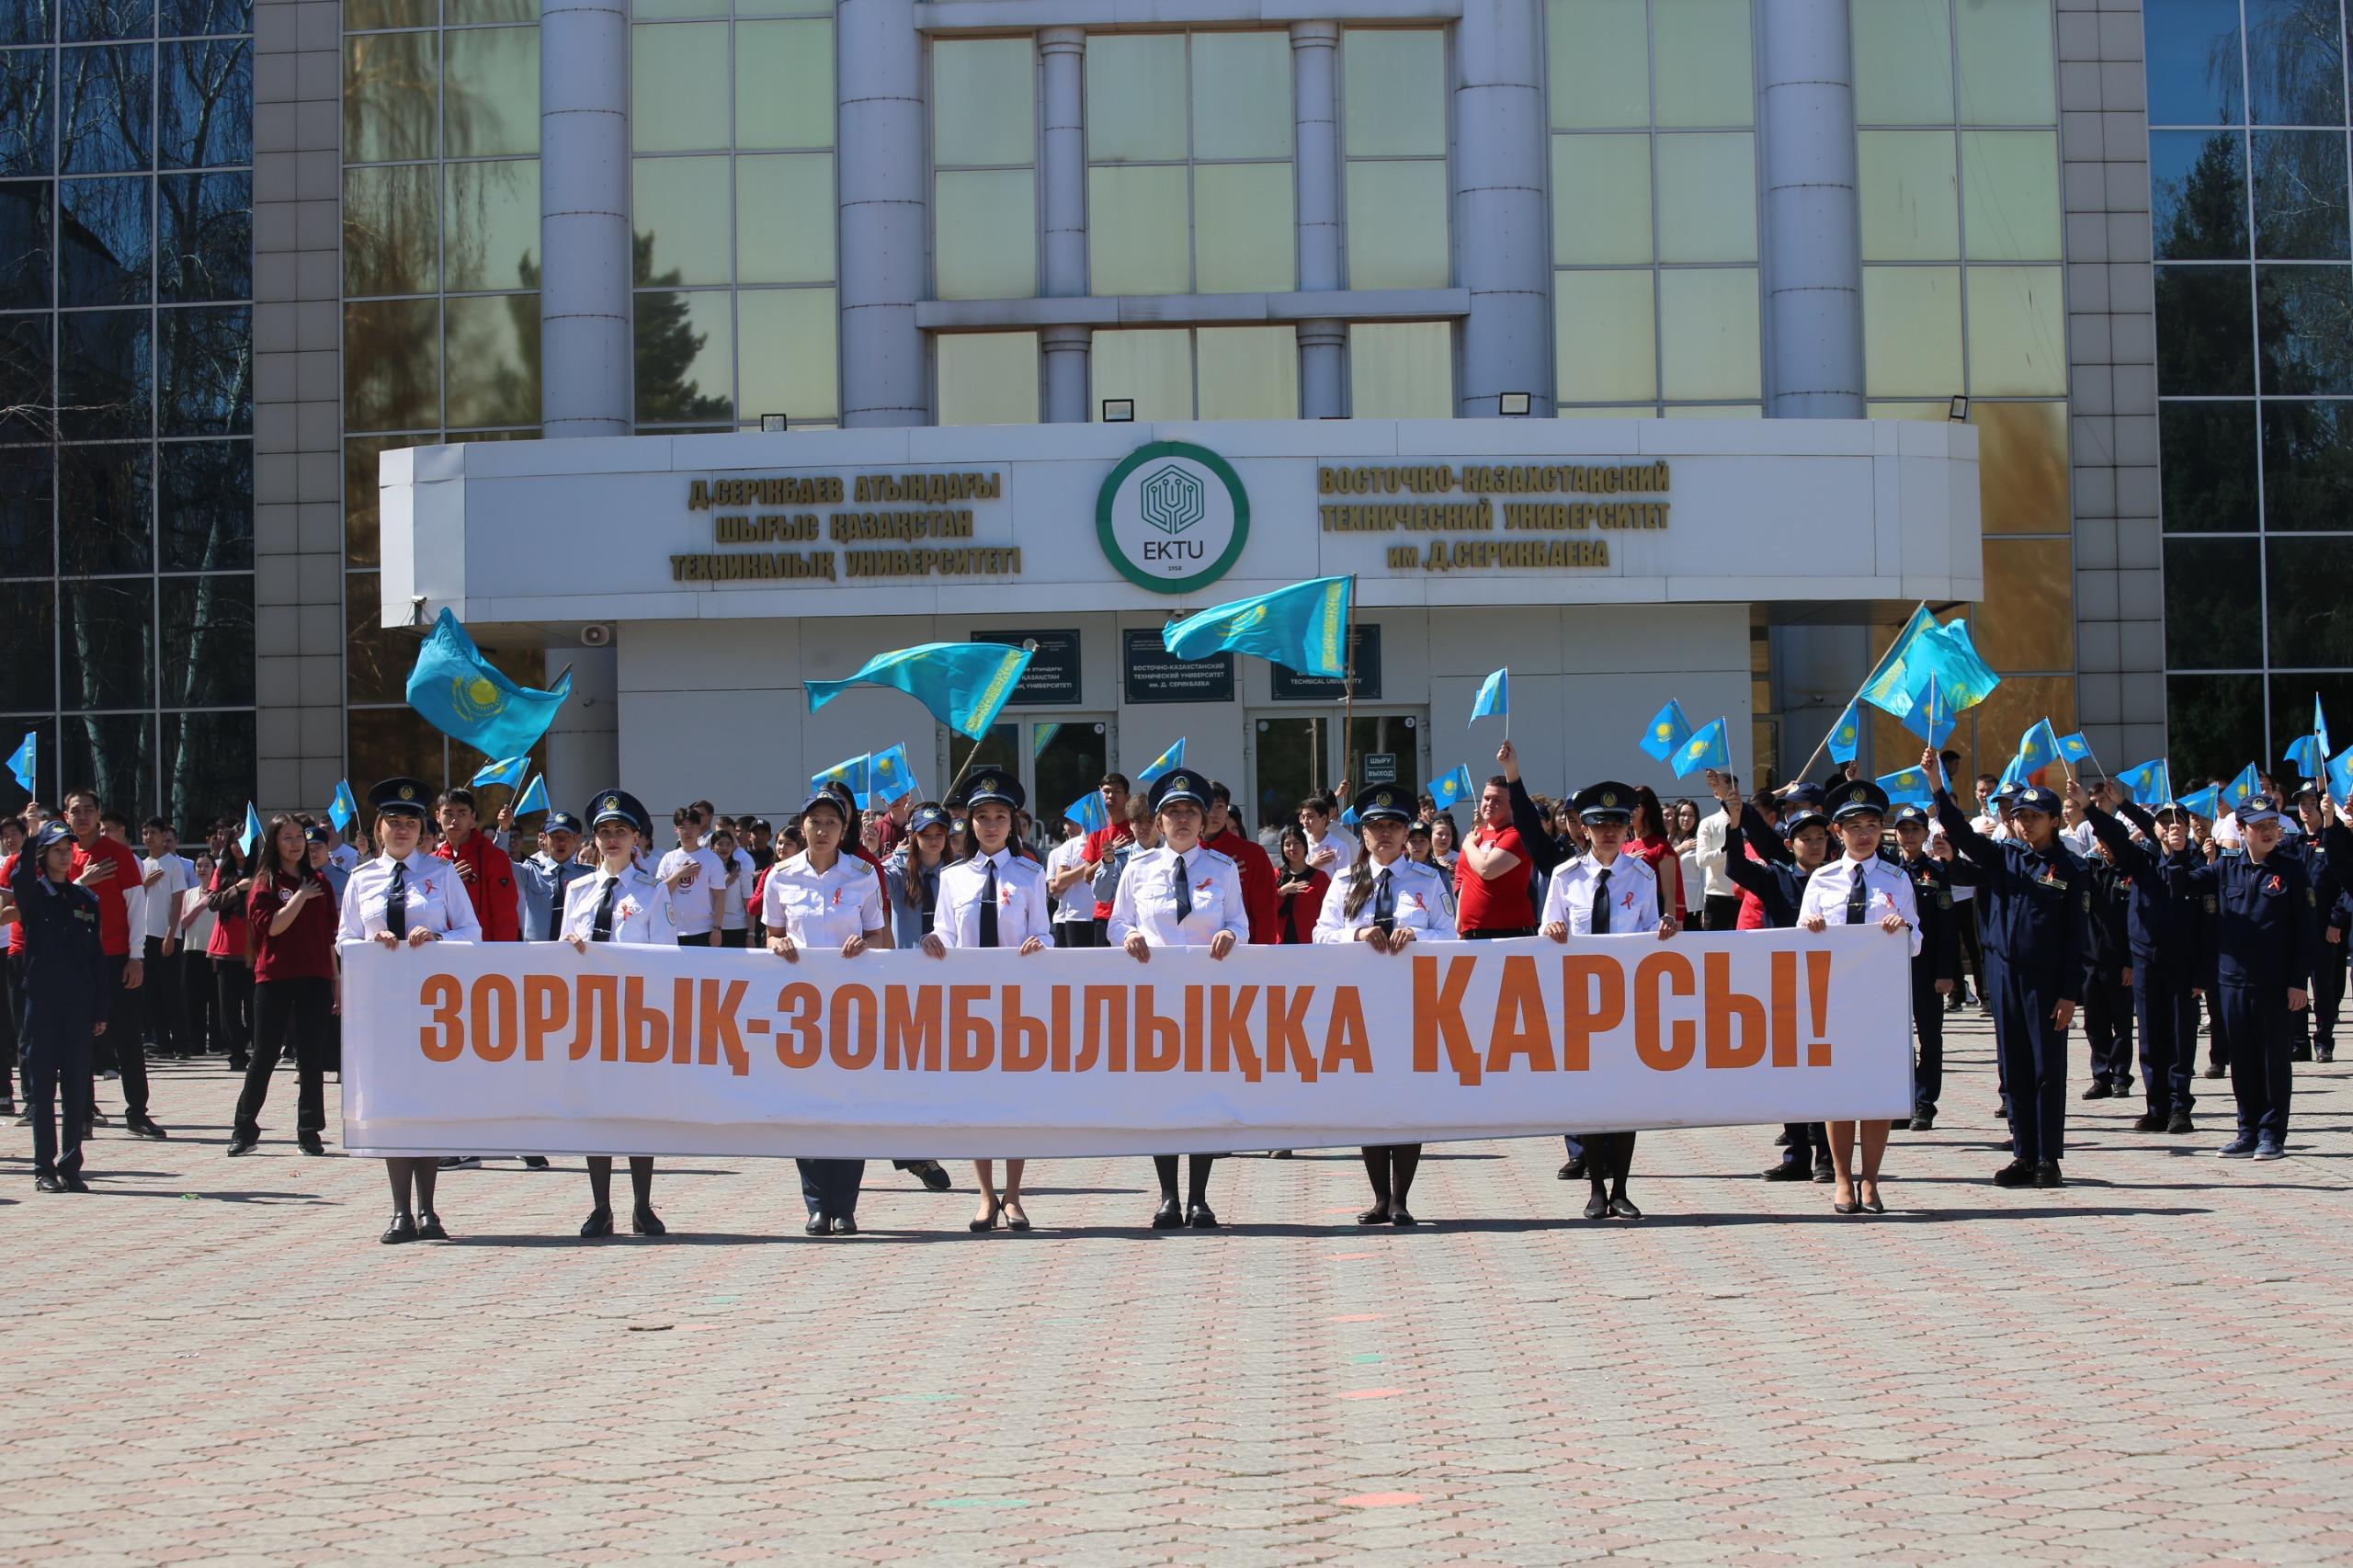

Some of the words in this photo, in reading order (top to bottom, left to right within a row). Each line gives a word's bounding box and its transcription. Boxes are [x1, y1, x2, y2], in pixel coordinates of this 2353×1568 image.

[854, 472, 1001, 504] АТЫНДАҒЫ
[1319, 460, 1670, 494] ВОСТОЧНО-КАЗАХСТАНСКИЙ
[715, 514, 819, 544] ШЫҒЫС
[829, 510, 974, 544] ҚАЗАҚСТАН
[1320, 498, 1494, 531] ТЕХНИЧЕСКИЙ
[1504, 502, 1670, 530] УНИВЕРСИТЕТ
[669, 551, 836, 583] ТЕХНИКАЛЫҚ
[845, 546, 1022, 578] УНИВЕРСИТЕТІ
[1142, 540, 1204, 561] EKTU
[1133, 663, 1225, 671] ВОСТОЧНО-КАЗАХСТАНСКИЙ
[420, 973, 1373, 1083] ЗОРЛЫҚ-ЗОМБЫЛЫҚҚА
[1413, 950, 1832, 1086] ҚАРСЫ!
